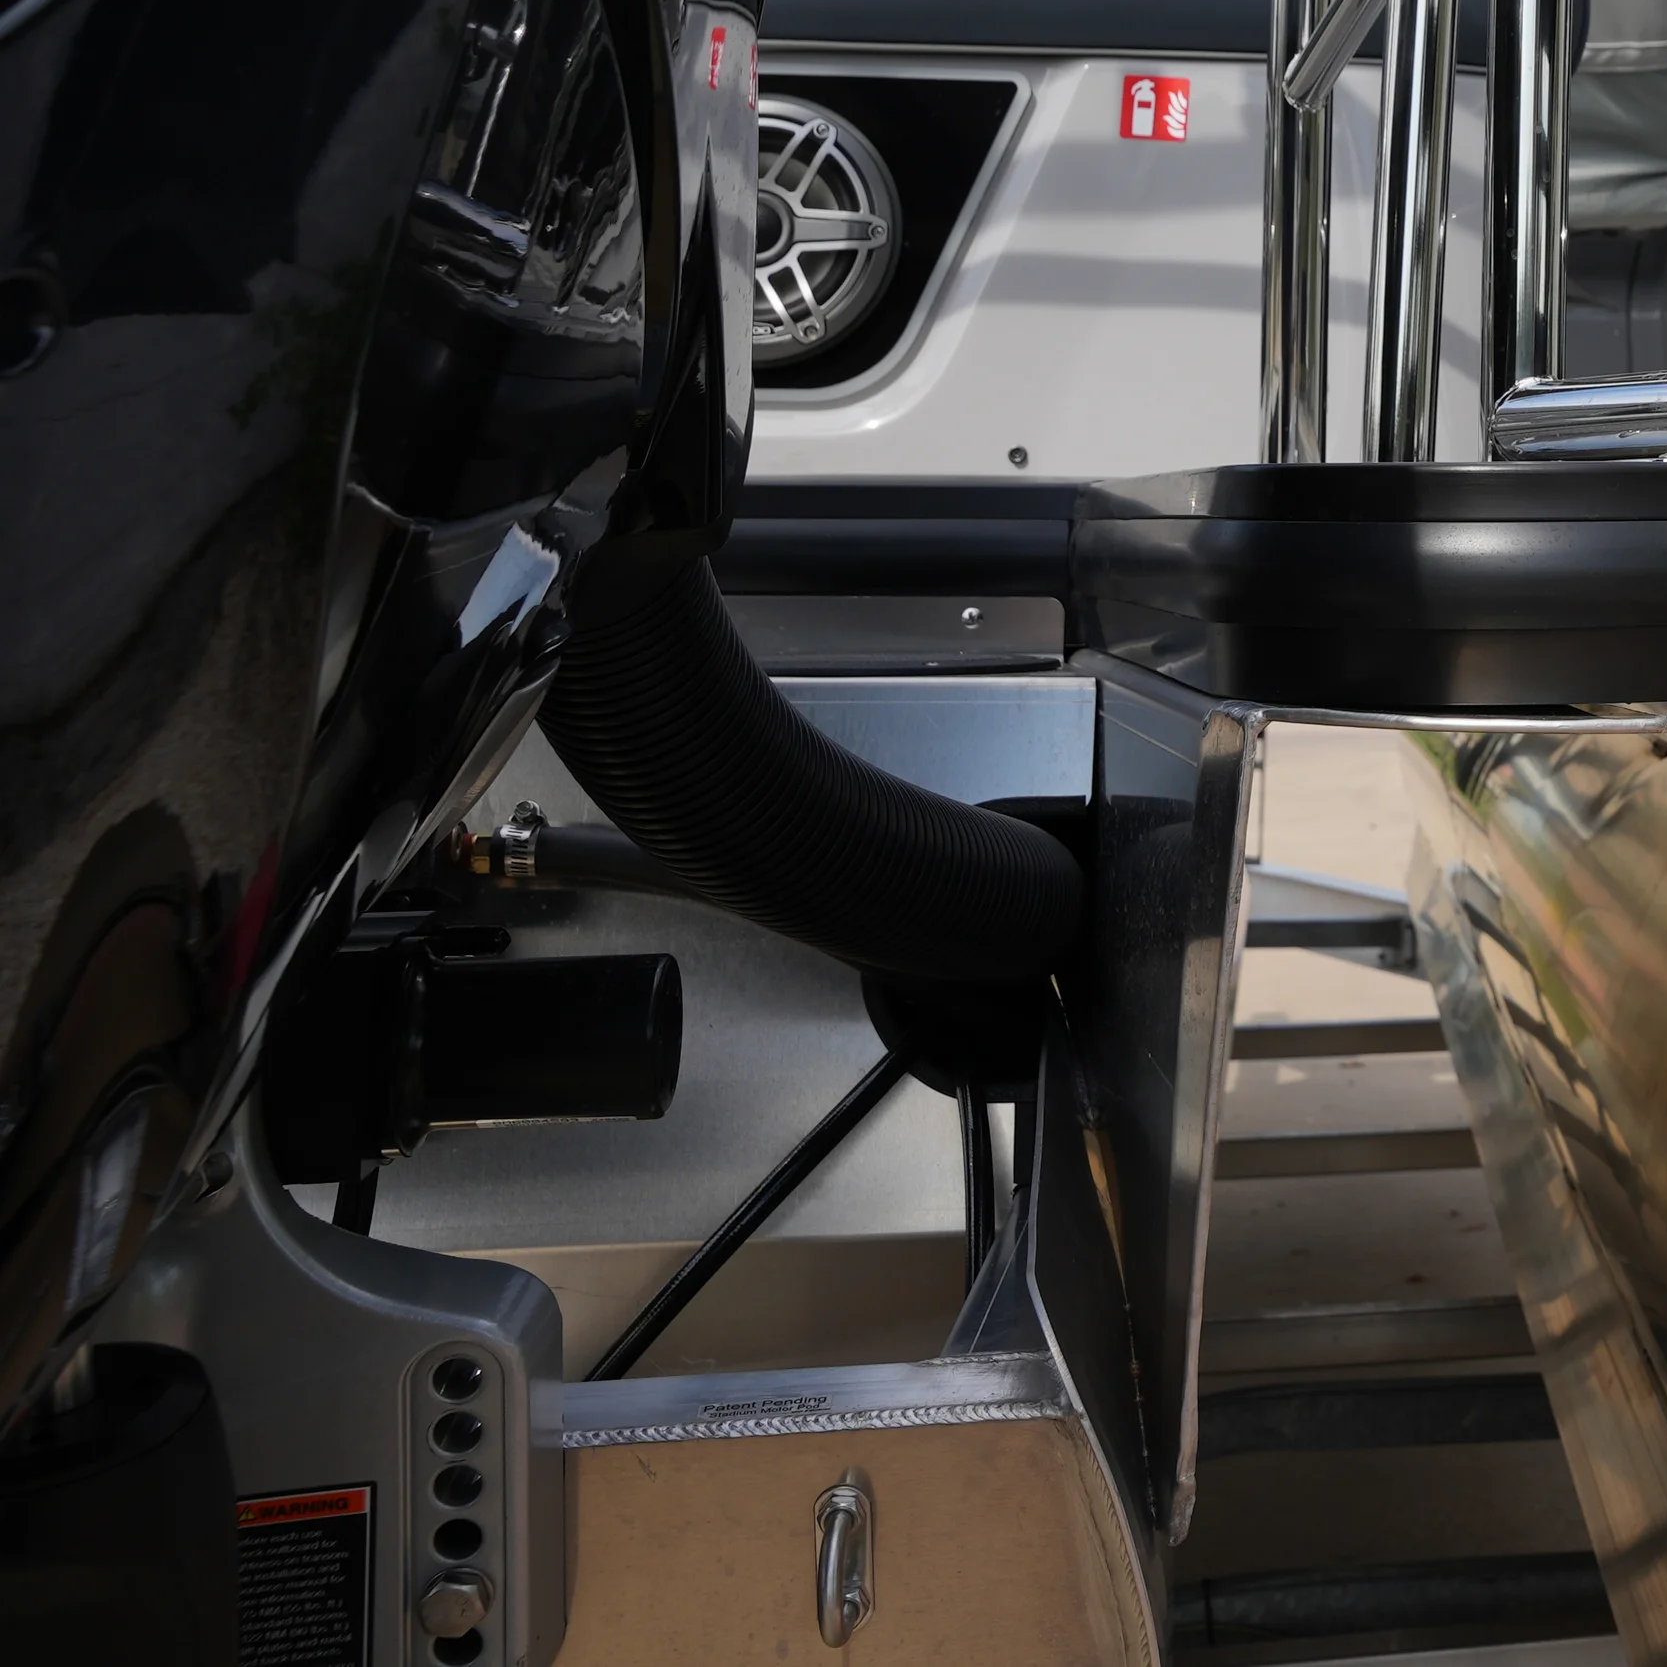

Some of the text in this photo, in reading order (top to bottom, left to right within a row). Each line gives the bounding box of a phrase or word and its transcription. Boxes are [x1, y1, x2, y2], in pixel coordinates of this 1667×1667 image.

[703, 1396, 827, 1413] Patent Pending
[709, 1409, 757, 1418] Stadium
[760, 1406, 794, 1414] Motor
[258, 1497, 349, 1518] WARNING
